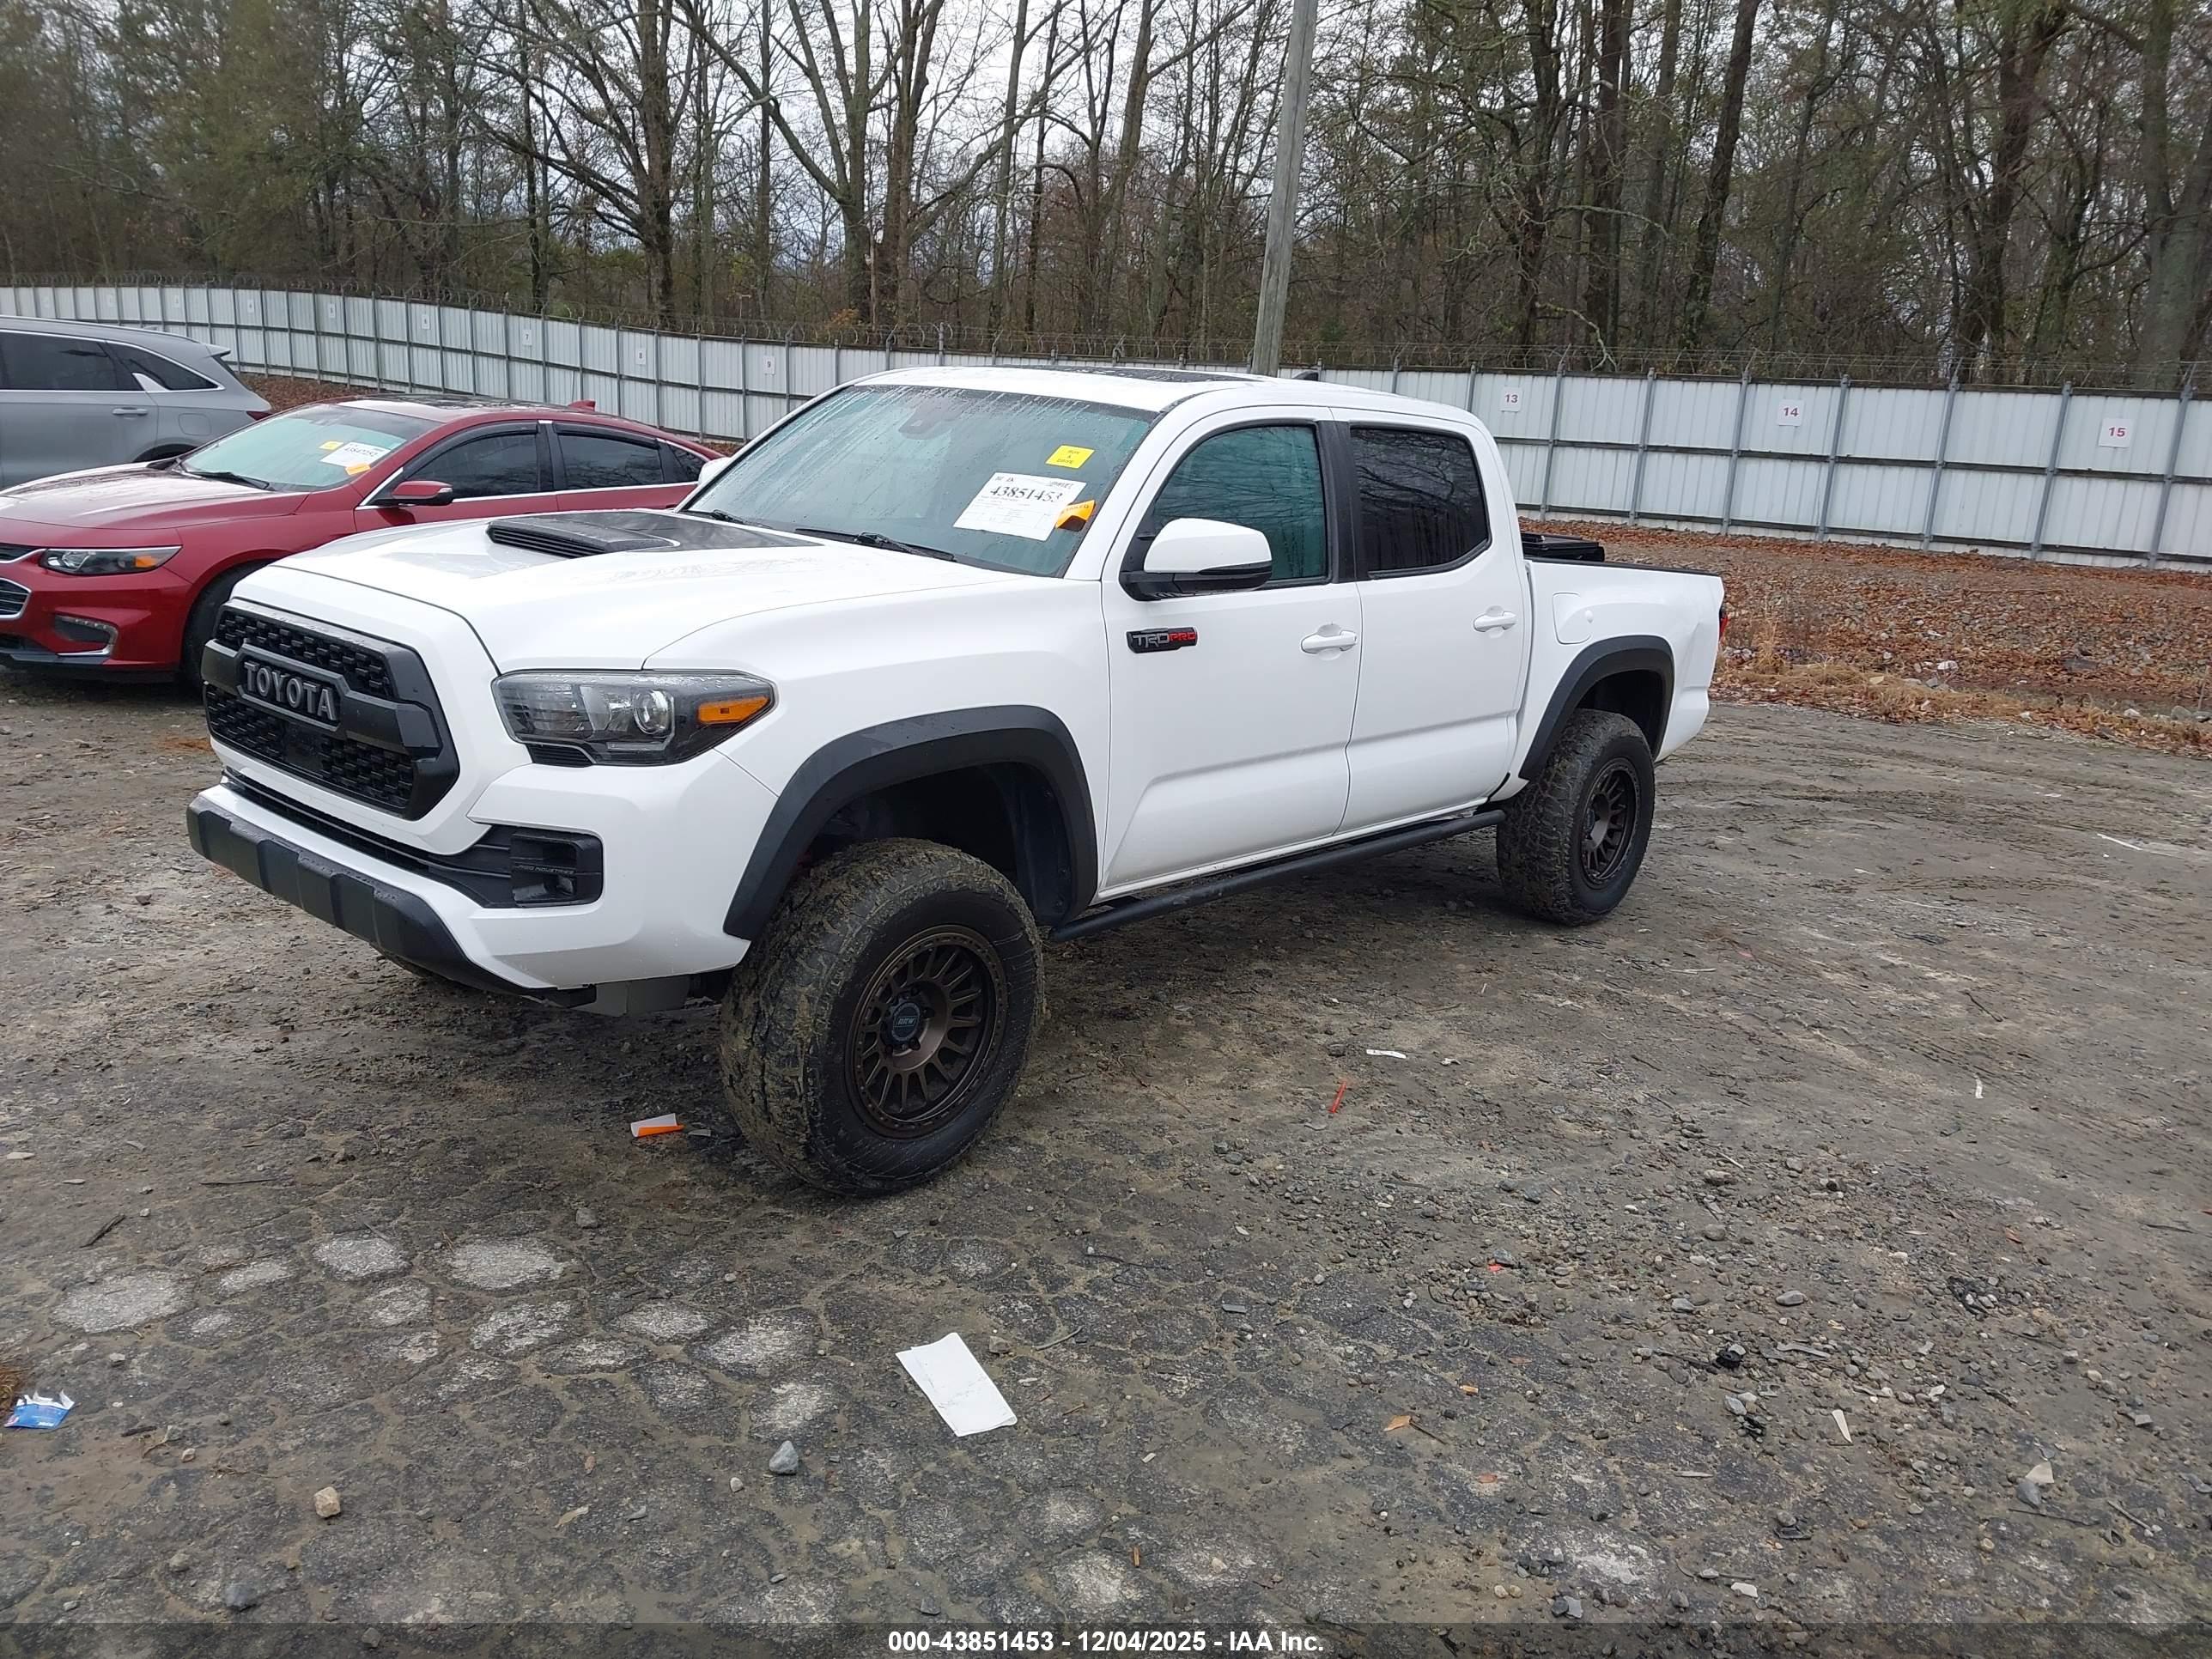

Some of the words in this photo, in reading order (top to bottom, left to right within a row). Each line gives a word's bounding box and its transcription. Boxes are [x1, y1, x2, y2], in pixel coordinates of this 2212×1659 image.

[1504, 394, 1518, 404] 13
[1784, 407, 1799, 417] 14
[2108, 427, 2126, 437] 15
[990, 486, 1063, 502] 43851453
[1133, 632, 1170, 648] TRD
[1169, 631, 1196, 641] PRO
[243, 660, 337, 721] TOYOTA
